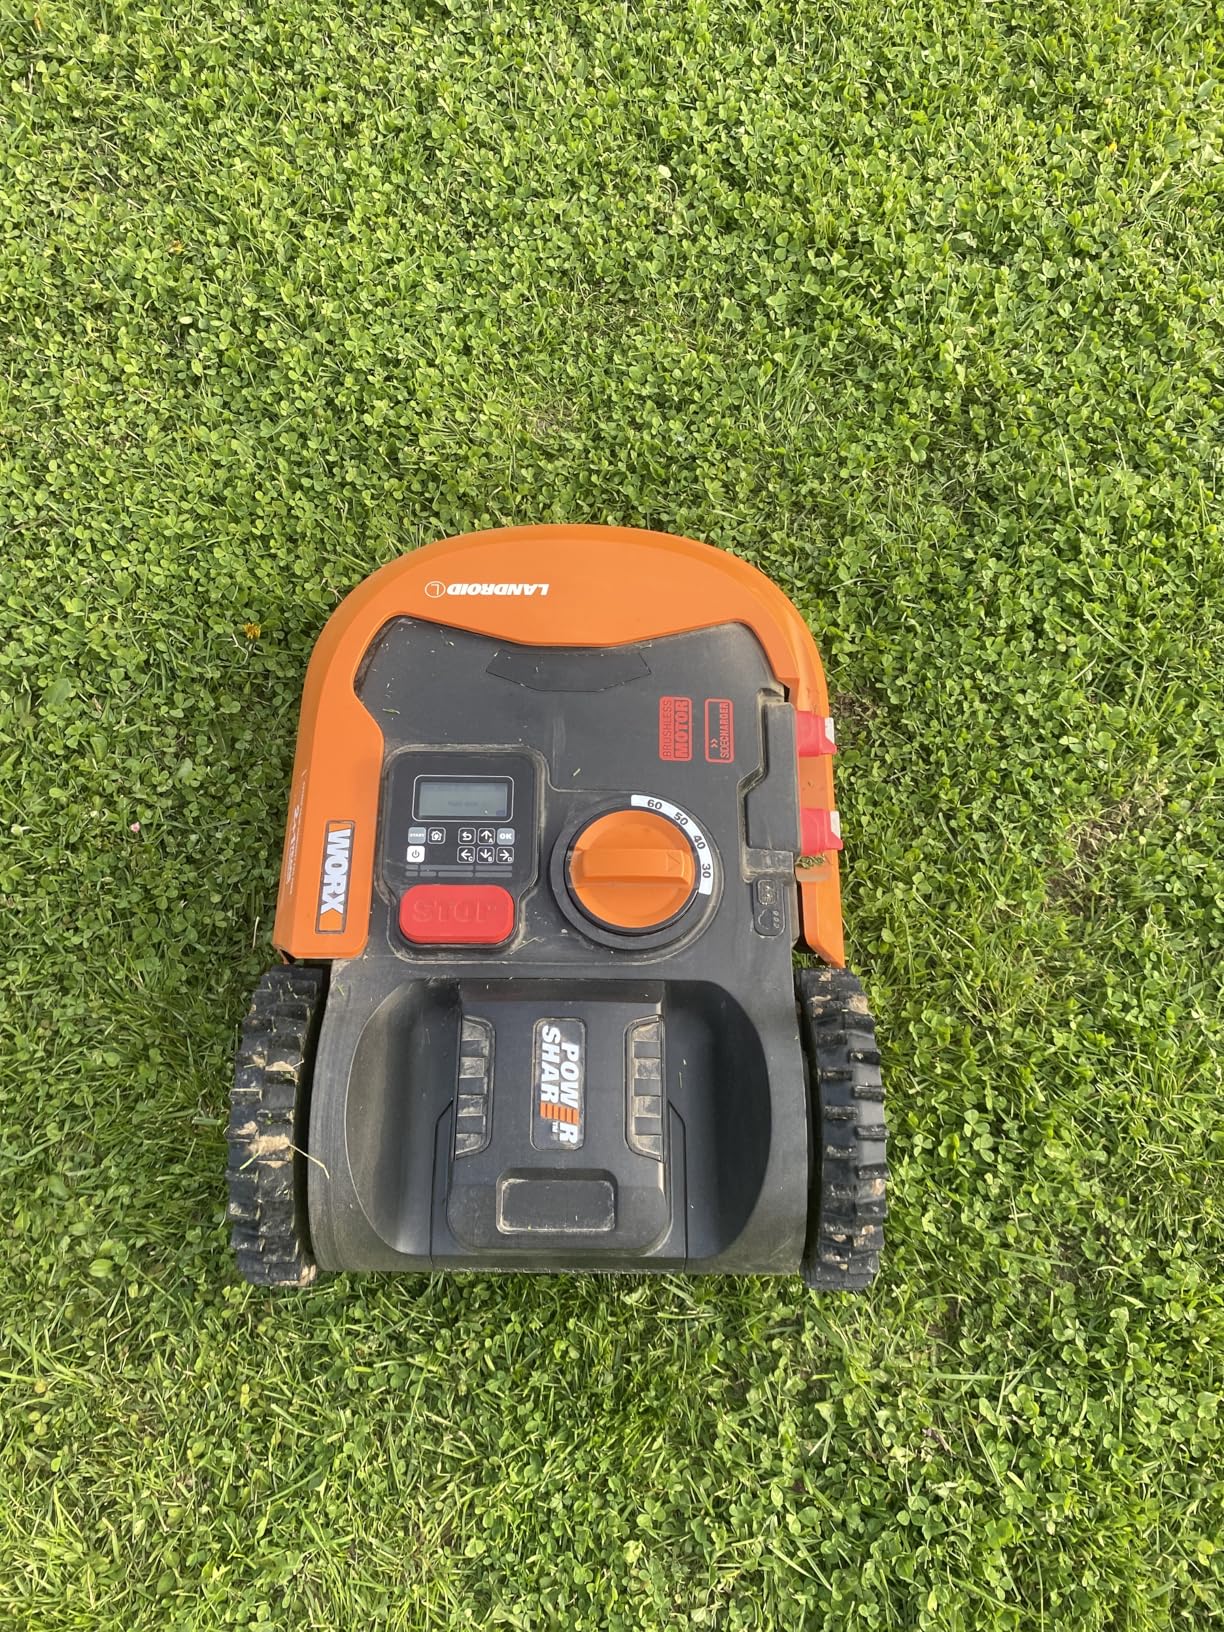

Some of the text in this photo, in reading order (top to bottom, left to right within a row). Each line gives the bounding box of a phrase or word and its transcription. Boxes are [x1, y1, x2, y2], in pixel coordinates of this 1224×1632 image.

[446, 583, 550, 596] LANDROID
[662, 700, 673, 758] BRUSHLESS
[674, 700, 689, 758] MOTOR
[646, 799, 663, 810] 60
[673, 811, 689, 826] 50
[499, 832, 513, 840] OK
[693, 835, 706, 850] 40
[320, 828, 352, 915] WORX
[701, 863, 712, 879] 30
[412, 899, 498, 923] STOP
